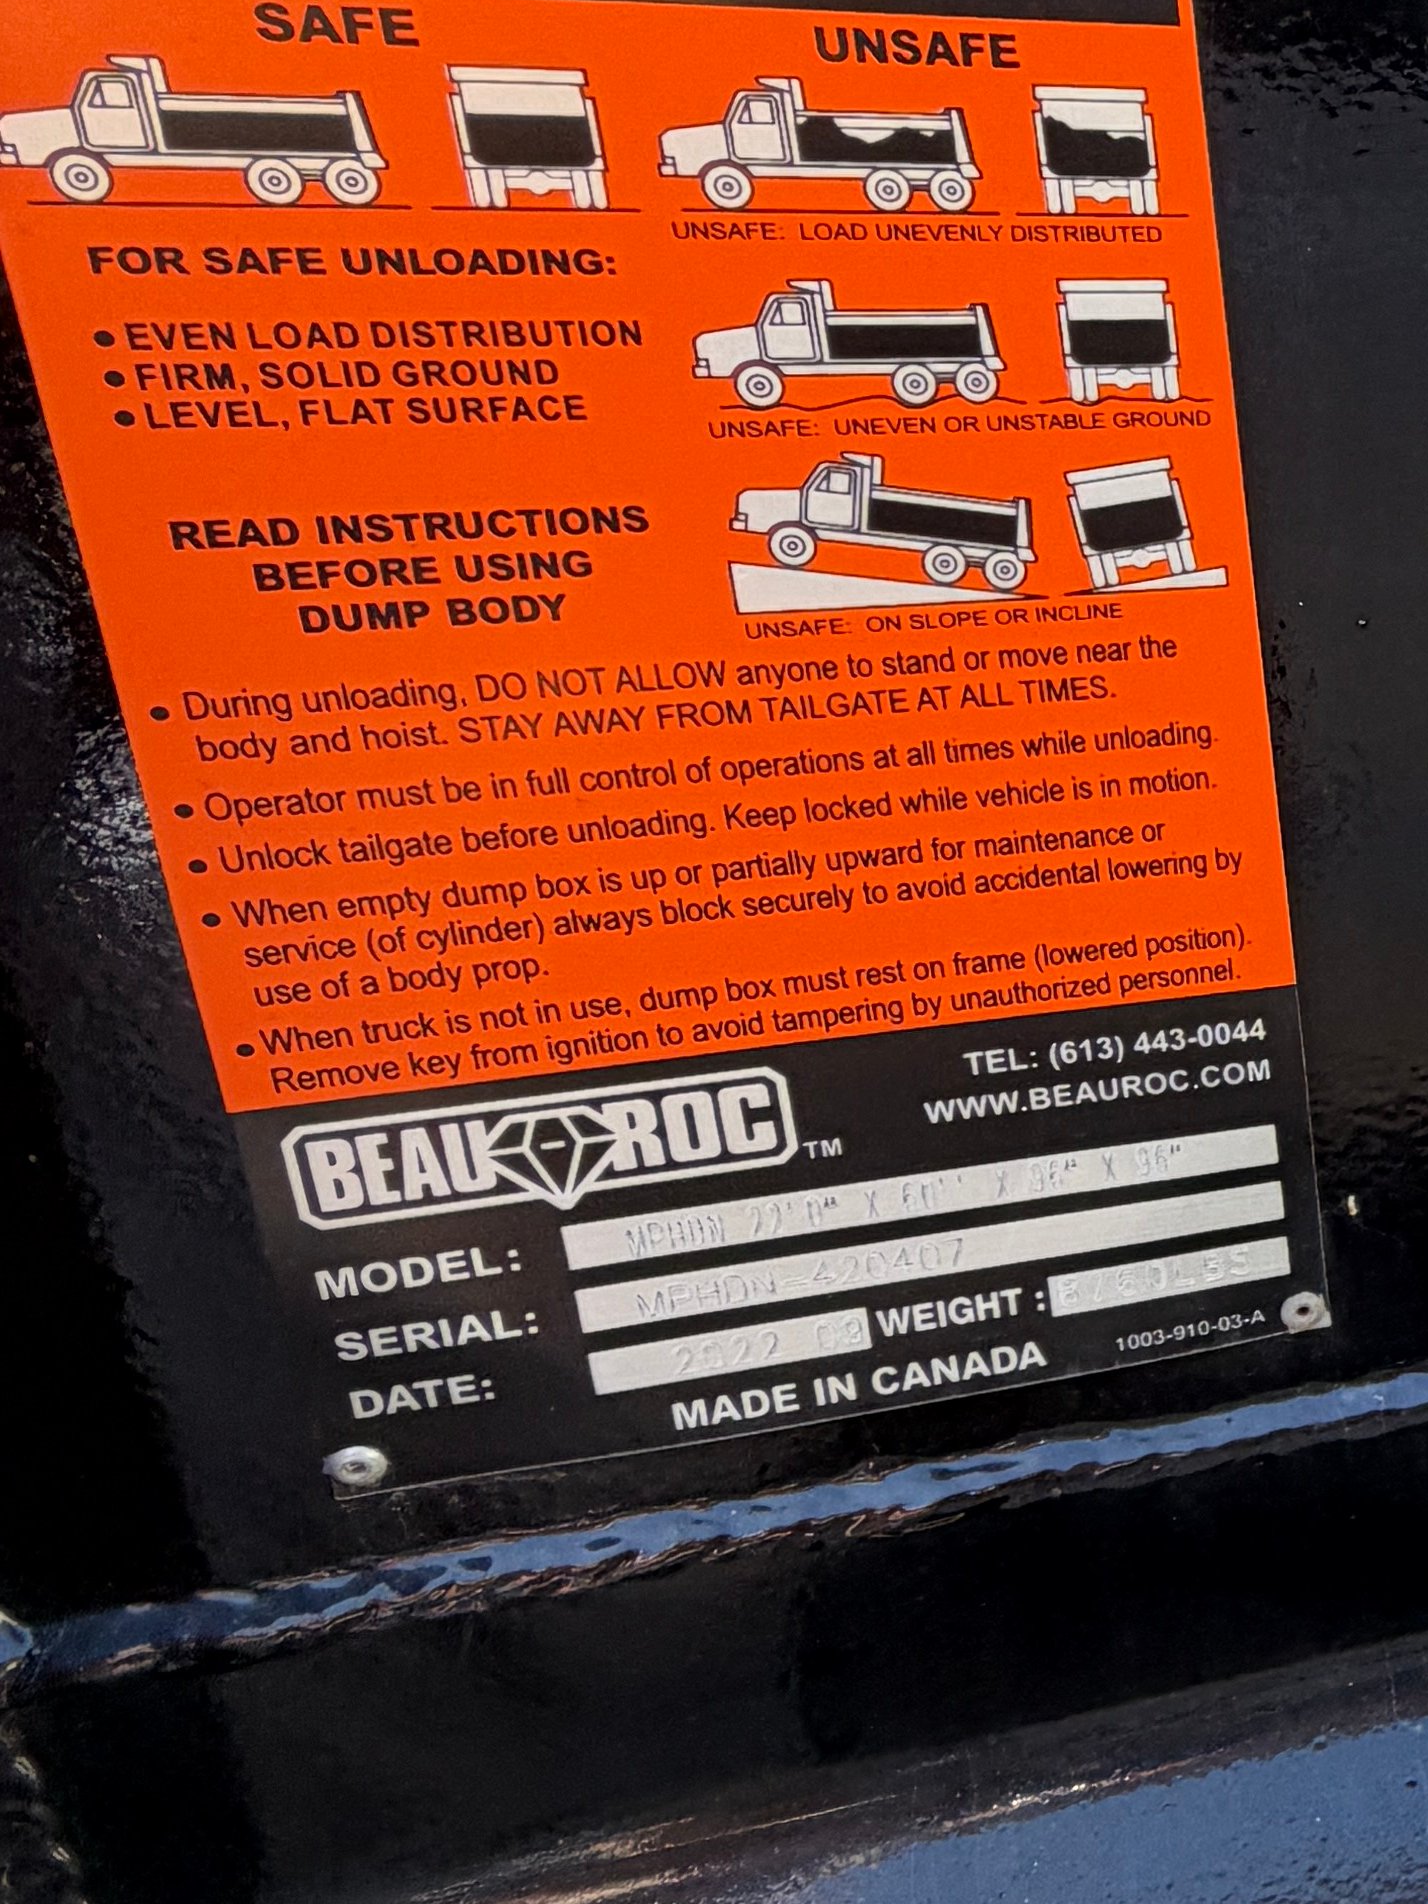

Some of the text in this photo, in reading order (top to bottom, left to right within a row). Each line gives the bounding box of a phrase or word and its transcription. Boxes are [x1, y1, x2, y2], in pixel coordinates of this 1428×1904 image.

[254, 2, 419, 46] SAFE
[814, 26, 1020, 68] UNSAFE
[672, 222, 1161, 242] UNSAFE: LOAD UNEVENLY DISTRIBUTED
[87, 246, 616, 275] FOR SAFE UNLOADING:
[124, 320, 642, 350] EVEN LOAD DISTRIBUTION
[134, 359, 558, 394] FIRM, SOLID GROUND
[144, 395, 587, 431] LEVEL, FLAT SURFACE
[709, 410, 1210, 438] UNSAFE: UNEVEN OR UNSTABLE GROUND
[168, 505, 649, 550] READ INSTRUCTIONS
[252, 551, 592, 592] BEFORE USING
[298, 594, 565, 633] DUMP BODY
[744, 603, 1122, 639] UNSAFE: ON SLOPE OR INCLINE
[182, 635, 1177, 721] During unloading, DO NOT ALLOW anyone to stand or move near the
[196, 676, 1115, 764] body and hoist. STAY AWAY FROM TAILGATE AT ALL TIMES.
[204, 722, 1218, 827] Operator must be in full control of operations at all times while unloading.
[218, 768, 1215, 873] Unlock tailgate before unloading. Keep locked while vehicle is in motion.
[231, 826, 1133, 928] When empty dump box is up or partially upward for maintenance
[244, 851, 1208, 967] service (of cylinder) always block securely to avoid accidental lowering
[254, 958, 549, 1007] use of body prop.
[259, 923, 1252, 1055] When truck is not in use, dump box must rest on frame (lowered position).
[270, 958, 1240, 1094] Remove key from ignition to avoid tampering by unauthorized personnel.
[963, 1018, 1266, 1075] TEL: (613) 443-0044
[924, 1059, 1271, 1124] WWW.BEAUROC.COM
[803, 1138, 842, 1159] TM
[315, 1248, 521, 1300] MODEL:
[335, 1311, 538, 1360] SERIAL:
[1117, 1310, 1265, 1353] 1003-910-03-A
[350, 1375, 494, 1418] DATE:
[672, 1342, 1047, 1432] MADE IN CANADA
